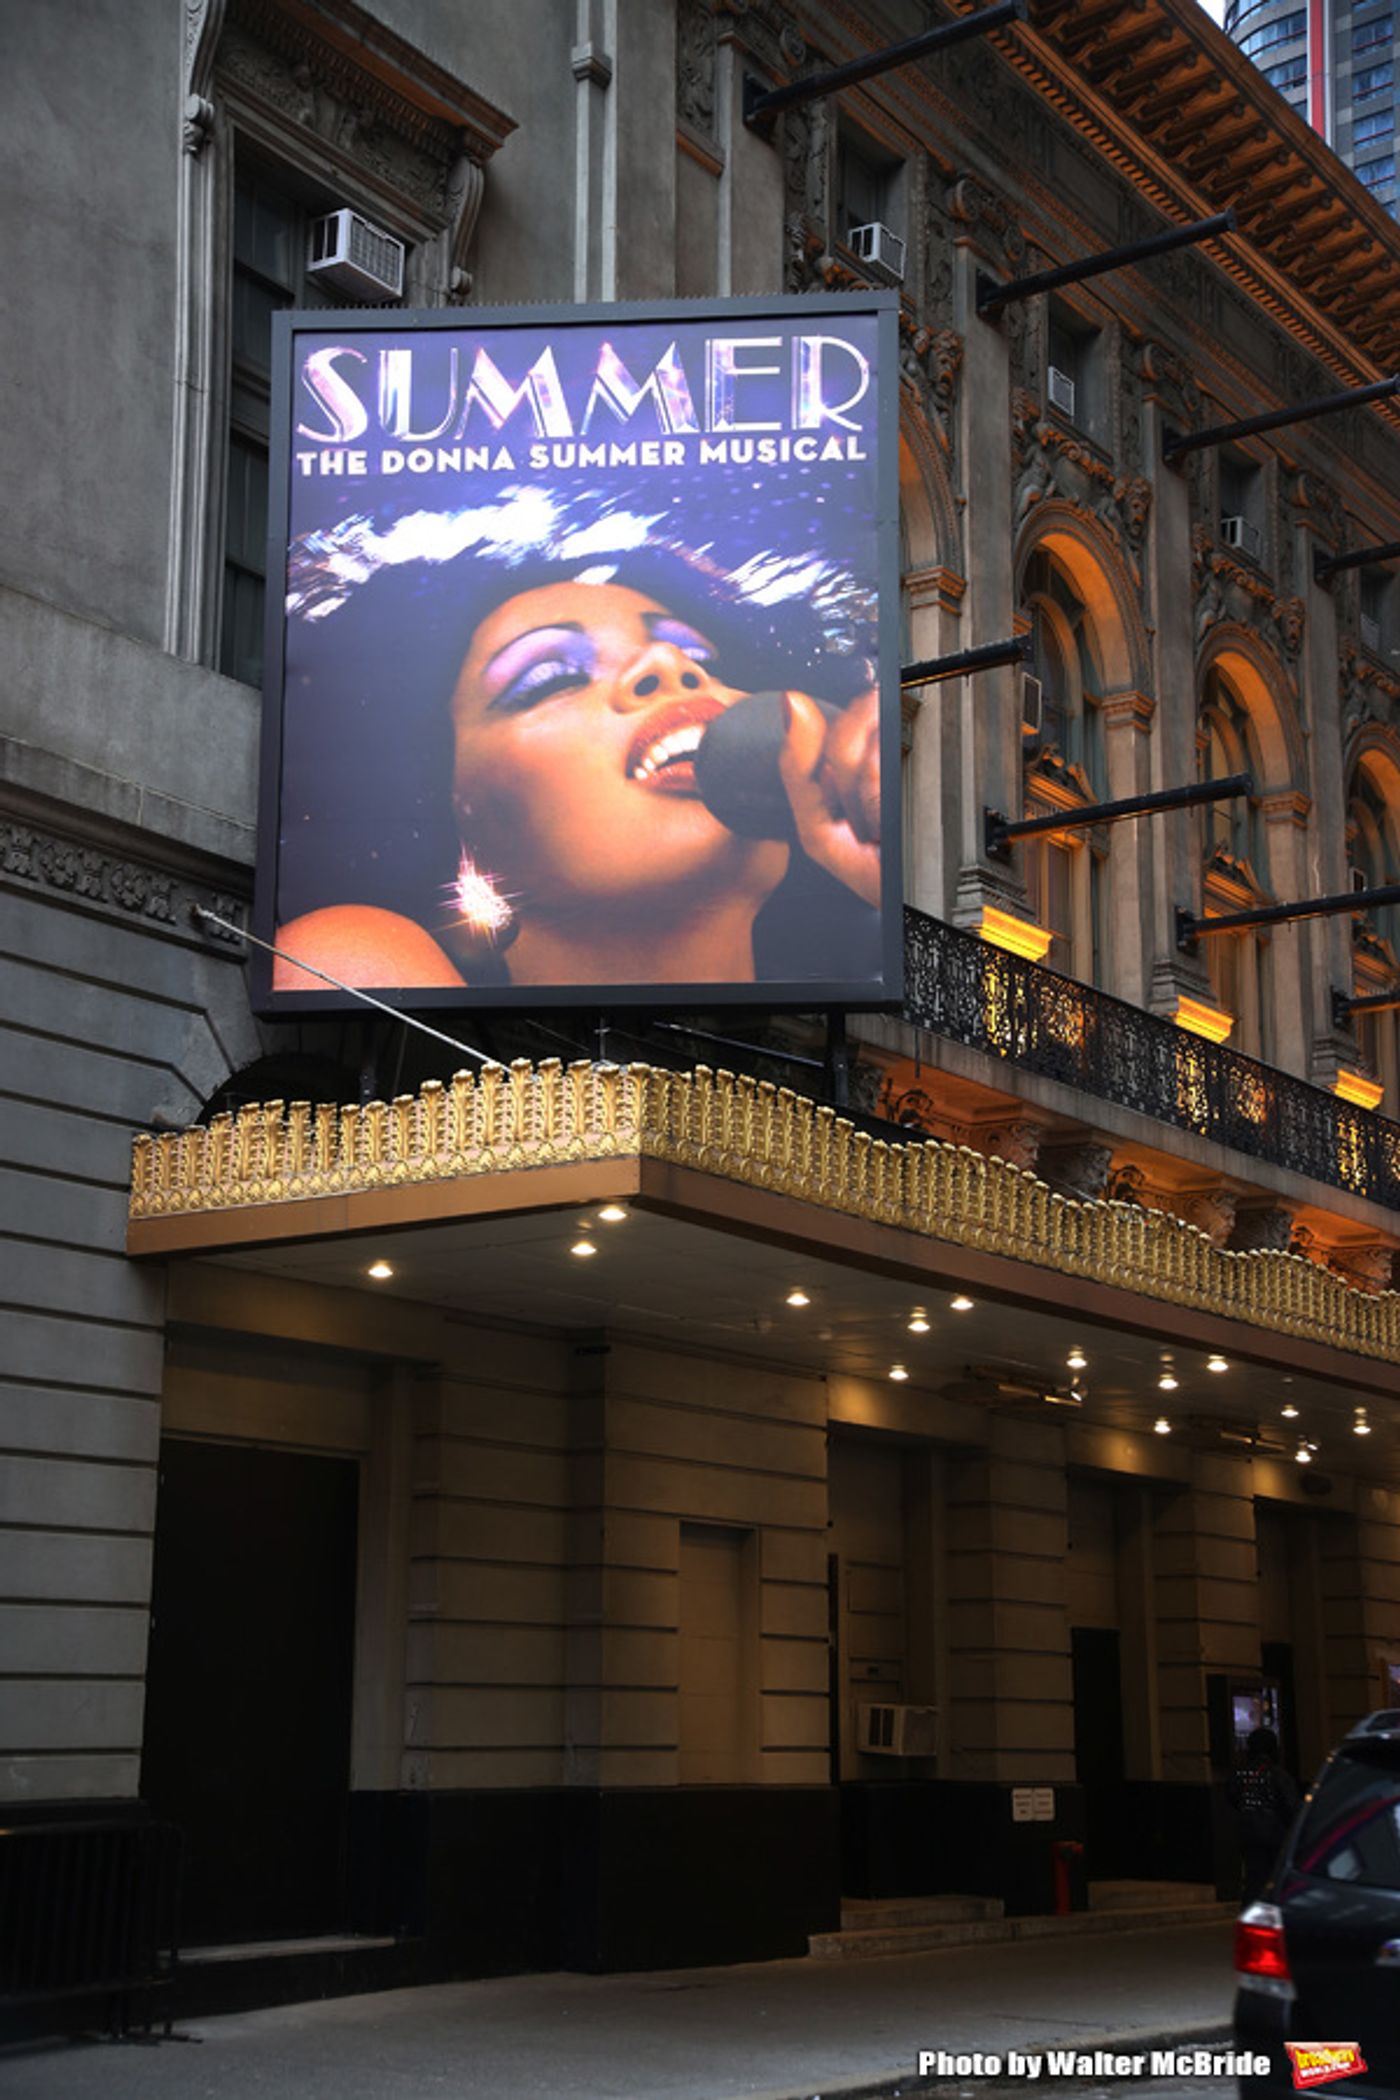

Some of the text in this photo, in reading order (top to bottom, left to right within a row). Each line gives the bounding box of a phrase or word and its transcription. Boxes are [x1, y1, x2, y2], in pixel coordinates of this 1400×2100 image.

[296, 335, 870, 443] SUMMER
[297, 435, 867, 476] THE DONNA SUMMER MUSICAL
